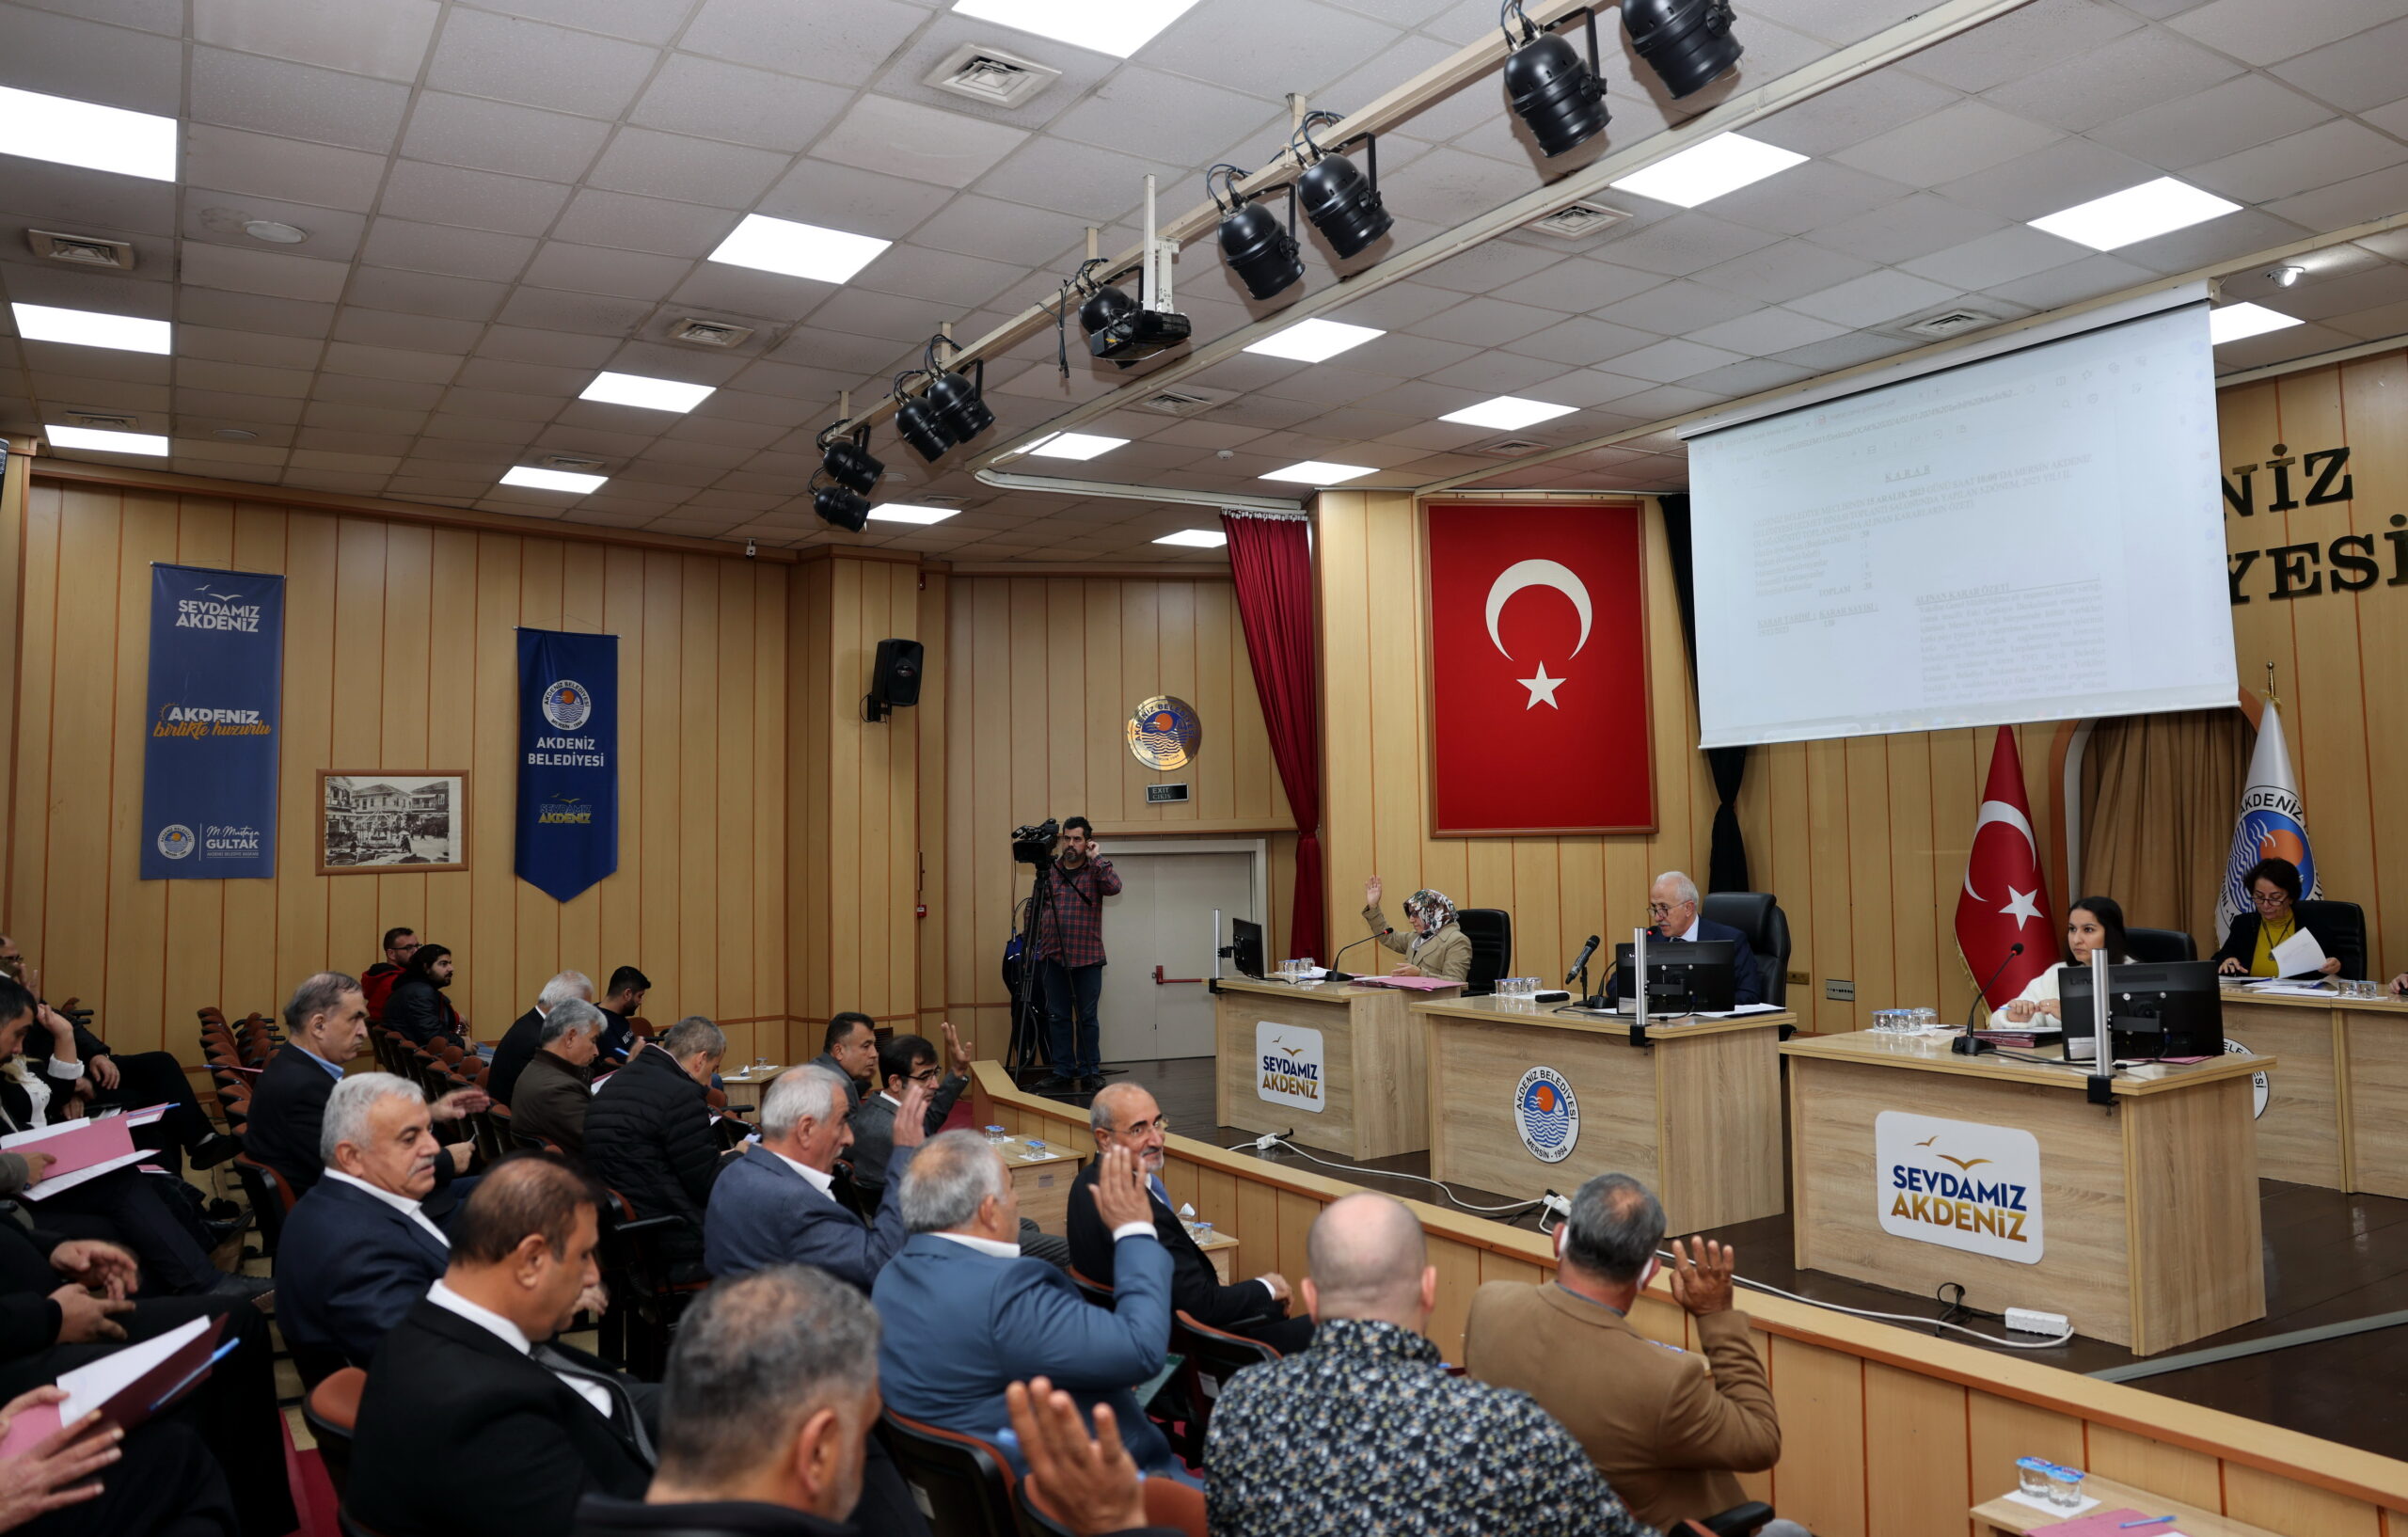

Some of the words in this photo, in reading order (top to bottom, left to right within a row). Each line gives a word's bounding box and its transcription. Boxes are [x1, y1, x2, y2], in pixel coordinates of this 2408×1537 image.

[1877, 490, 1908, 503] ARALIK
[1909, 487, 1925, 497] 2023
[1951, 478, 1973, 489] SAAT
[2014, 462, 2049, 477] MERSİN
[1940, 488, 1977, 502] YAPILAN
[1948, 587, 1980, 600] KARAR
[178, 600, 261, 619] SEVDAMIZ
[175, 613, 259, 633] AKDENİZ
[153, 721, 210, 740] birlikte
[212, 720, 272, 737] huzurlu
[536, 736, 595, 751] AKDENİZ
[528, 752, 605, 768] BELEDİYESİ
[538, 813, 592, 824] AKDENİZ
[540, 804, 592, 814] SEVDAMIZ
[1263, 1055, 1318, 1081] SEVDAMIZ
[1262, 1072, 1318, 1100] AKDENİZ
[1516, 1070, 1539, 1111] AKDENİZ
[1540, 1070, 1577, 1120] BELEDİYESİ
[1526, 1138, 1549, 1159] MERSİN
[1554, 1145, 1568, 1159] 1994
[1893, 1165, 2027, 1212] SEVDAMIZ
[1891, 1191, 2028, 1243] AKDENİZ
